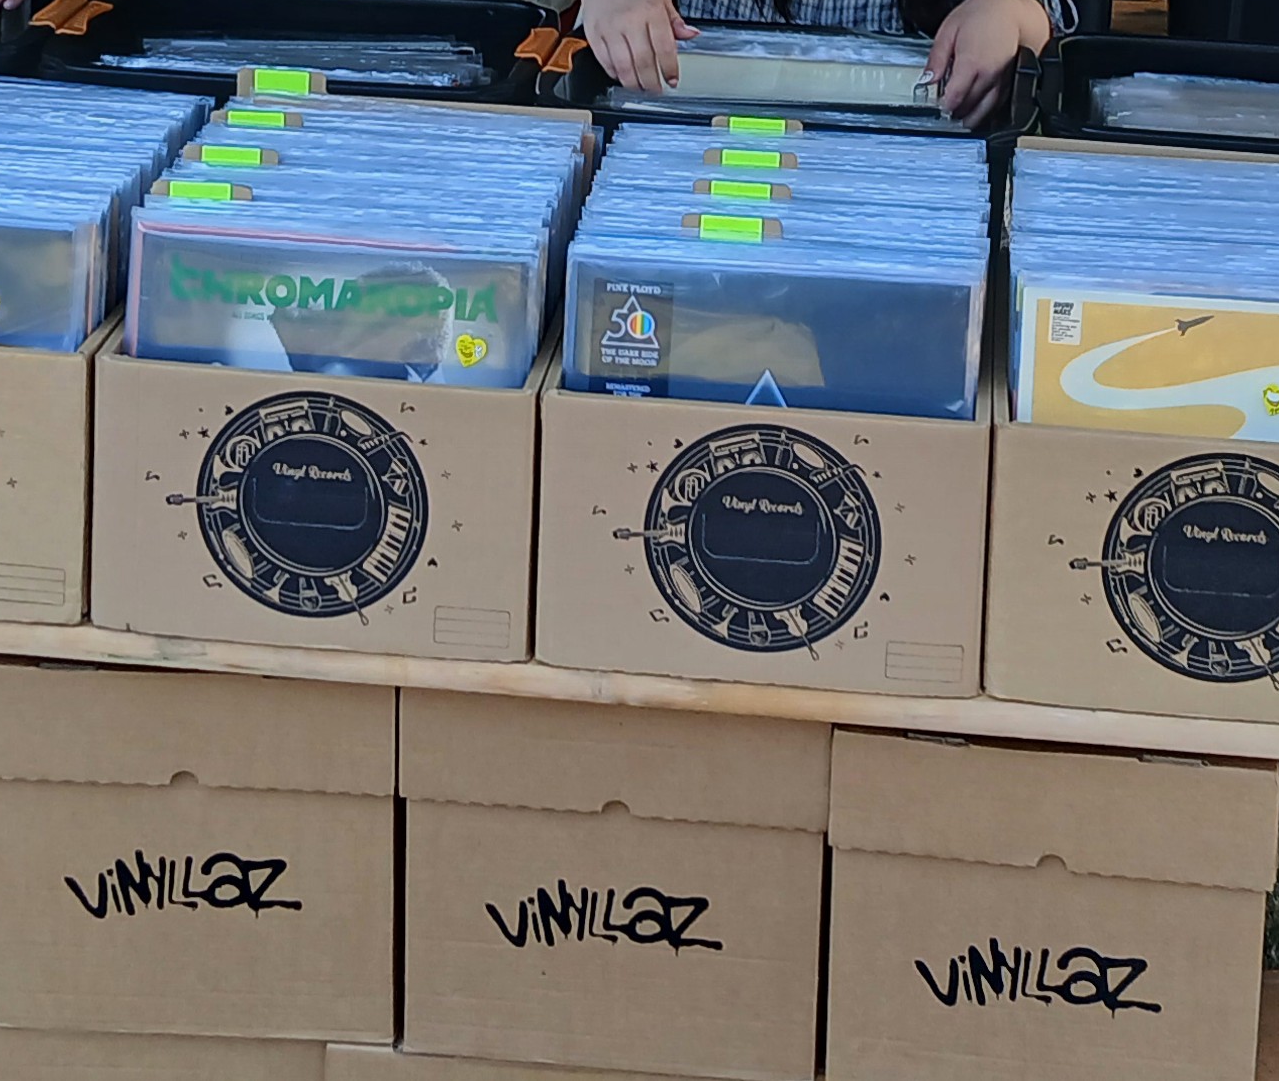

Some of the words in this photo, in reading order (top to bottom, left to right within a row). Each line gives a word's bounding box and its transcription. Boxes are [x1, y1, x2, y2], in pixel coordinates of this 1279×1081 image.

[606, 282, 628, 293] PINK
[629, 284, 662, 295] FLOYD
[272, 462, 307, 480] Vinyl
[721, 495, 757, 513] Vinyl
[1183, 524, 1220, 542] Vinyl
